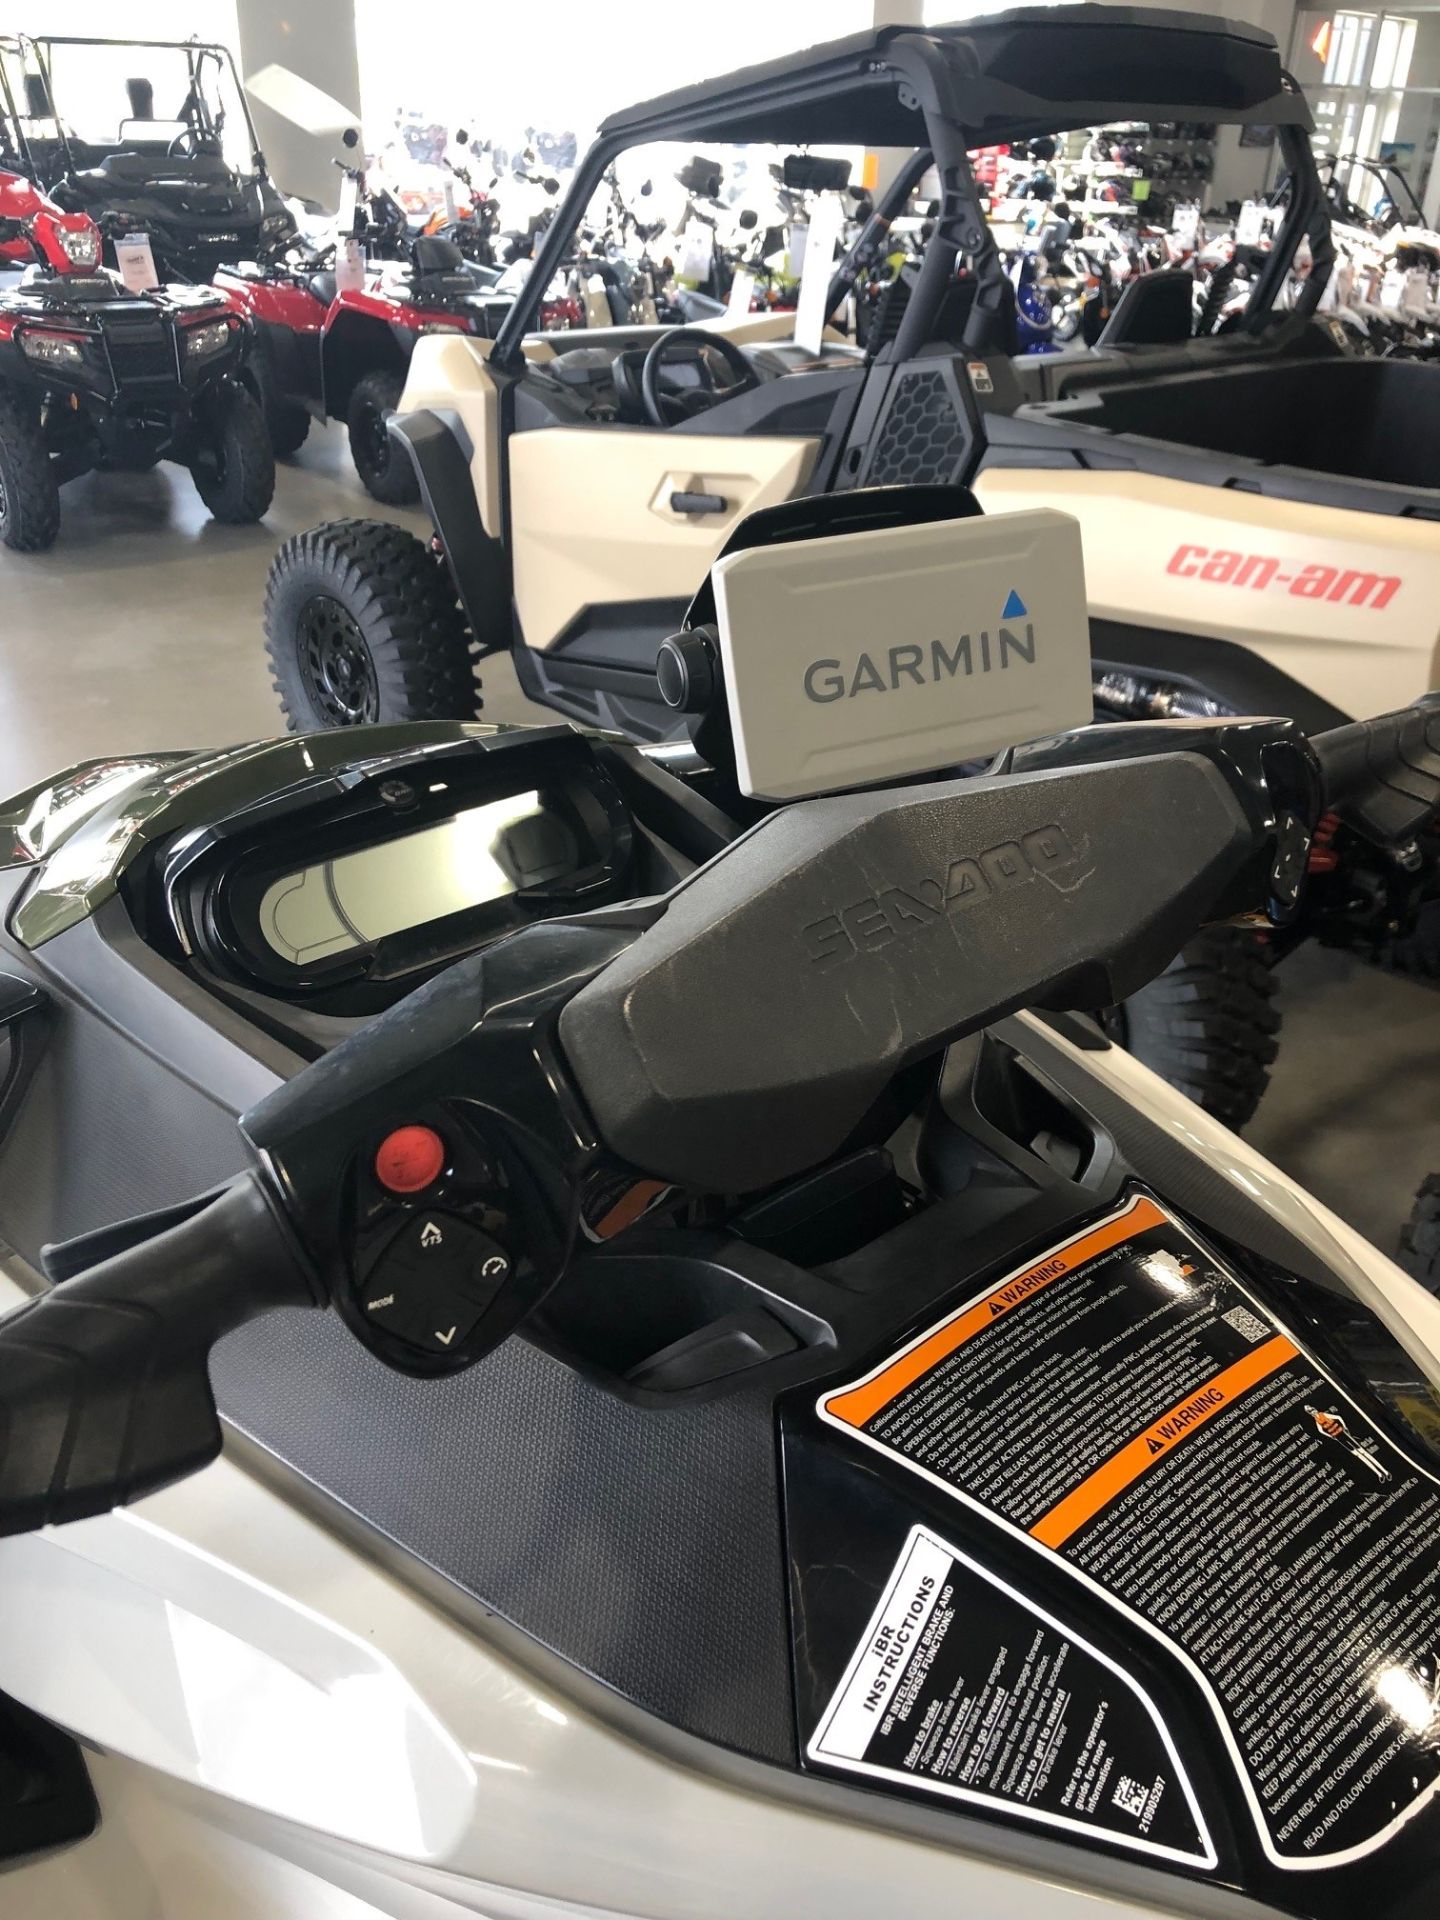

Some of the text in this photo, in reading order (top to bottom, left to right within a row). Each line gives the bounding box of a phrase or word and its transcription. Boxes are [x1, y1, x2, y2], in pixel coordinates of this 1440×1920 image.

[1166, 544, 1403, 610] can-am
[803, 623, 1037, 703] GARMIN
[998, 1260, 1067, 1302] WARNING
[1157, 1387, 1225, 1440] WARNING
[863, 1576, 935, 1712] INSTRUCTIONS
[872, 1625, 895, 1658] iBR
[889, 1645, 926, 1715] INTELLIGENT
[921, 1608, 944, 1646] BRAKE
[938, 1585, 954, 1609] AND
[897, 1607, 955, 1721] REVERSE FUNCTIONS:
[1249, 1594, 1413, 1767] DO NOT APPLY THROTTLE WHEN ANYONE IS AT REAR OF PWC
[903, 1742, 920, 1767] How
[920, 1699, 940, 1730] brake
[920, 1676, 965, 1764] Squeeze brake lever
[930, 1749, 948, 1774] How
[949, 1697, 971, 1736] reverse
[948, 1646, 1008, 1772] Maintain brake lever engaged
[975, 1761, 990, 1778] Tap
[984, 1729, 1003, 1761] throttle
[997, 1706, 1012, 1729] lever
[1013, 1663, 1031, 1696] engage
[1025, 1629, 1044, 1663] forward
[977, 1728, 988, 1745] go
[982, 1686, 1005, 1728] forward
[989, 1742, 1013, 1789] movement
[1018, 1688, 1035, 1721] neutral
[1002, 1753, 1025, 1793] Squeeze
[1019, 1721, 1038, 1753] throttle
[1032, 1697, 1047, 1721] lever
[1047, 1642, 1070, 1688] accelerate
[1015, 1771, 1032, 1797] How
[1033, 1739, 1046, 1760] get
[1046, 1688, 1066, 1727] neutral
[958, 1756, 975, 1782] How
[1032, 1724, 1068, 1791] Tap brake lever
[1060, 1778, 1077, 1806] Refer
[1077, 1750, 1089, 1767] the
[1085, 1701, 1108, 1749] operator's
[1075, 1739, 1107, 1811] guide for more
[1082, 1756, 1114, 1813] information.
[1261, 1694, 1358, 1799] KEEP AWAY FROM INTAKE GRATE
[1276, 1712, 1397, 1842] NEVER RIDE AFTER CONSUMING DRUGS
[1138, 1775, 1166, 1833] 219905297
[1303, 1741, 1401, 1850] READ AND FOLLOW OPERATOR'S
